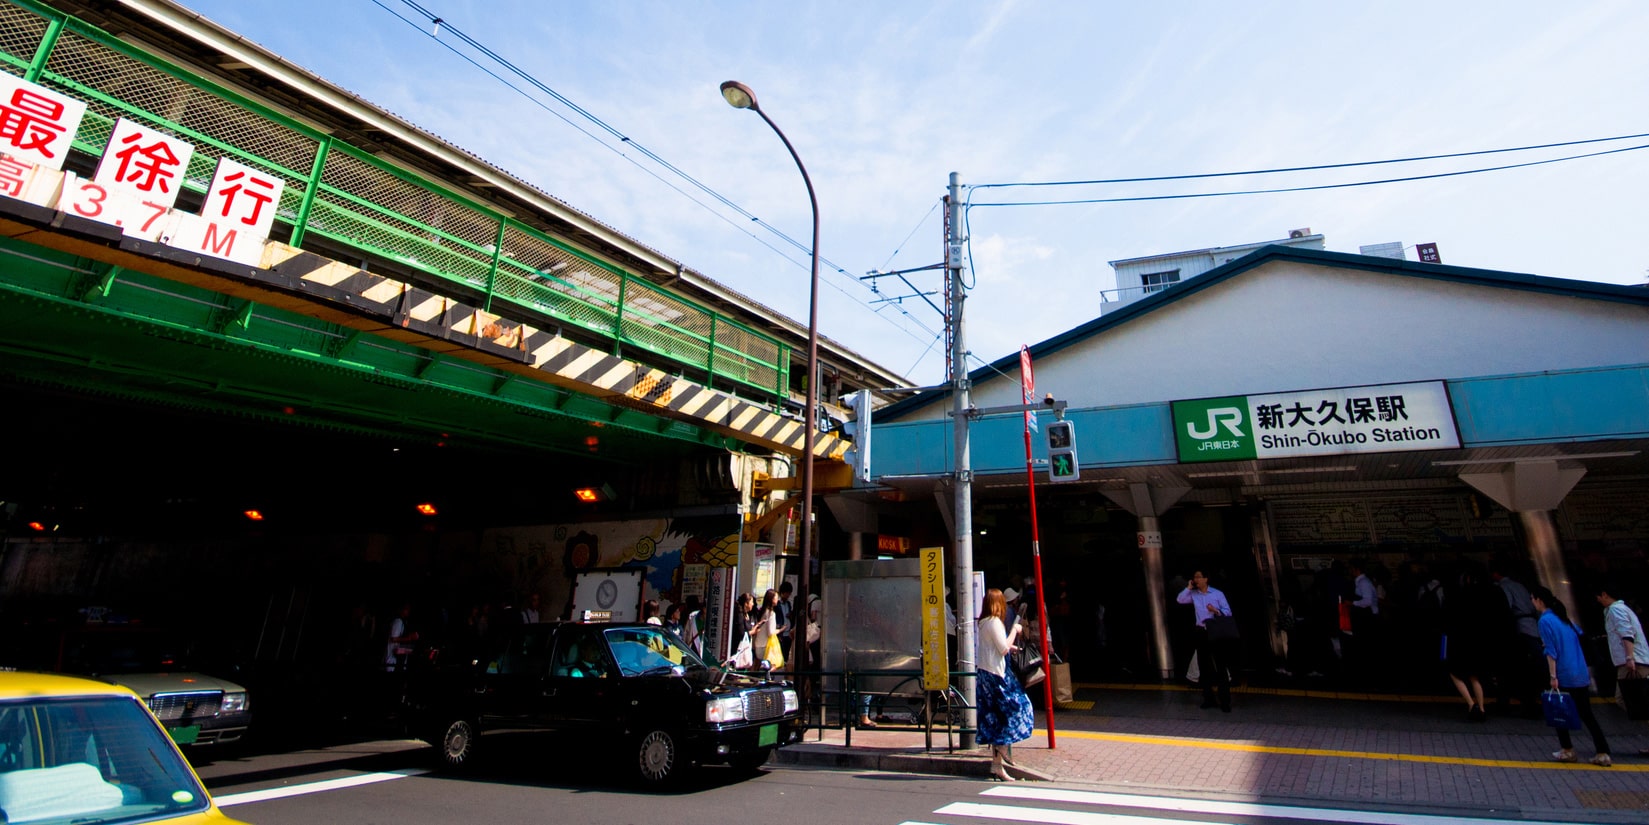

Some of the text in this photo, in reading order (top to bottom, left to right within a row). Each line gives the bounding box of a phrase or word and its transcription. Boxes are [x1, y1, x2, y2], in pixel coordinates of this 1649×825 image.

[1187, 407, 1246, 440] JR
[1257, 395, 1409, 430] 新大久保駅
[1197, 440, 1240, 452] JR東日本
[1261, 426, 1441, 449] Shin-Ōkubo Station
[879, 538, 897, 550] KIOSK
